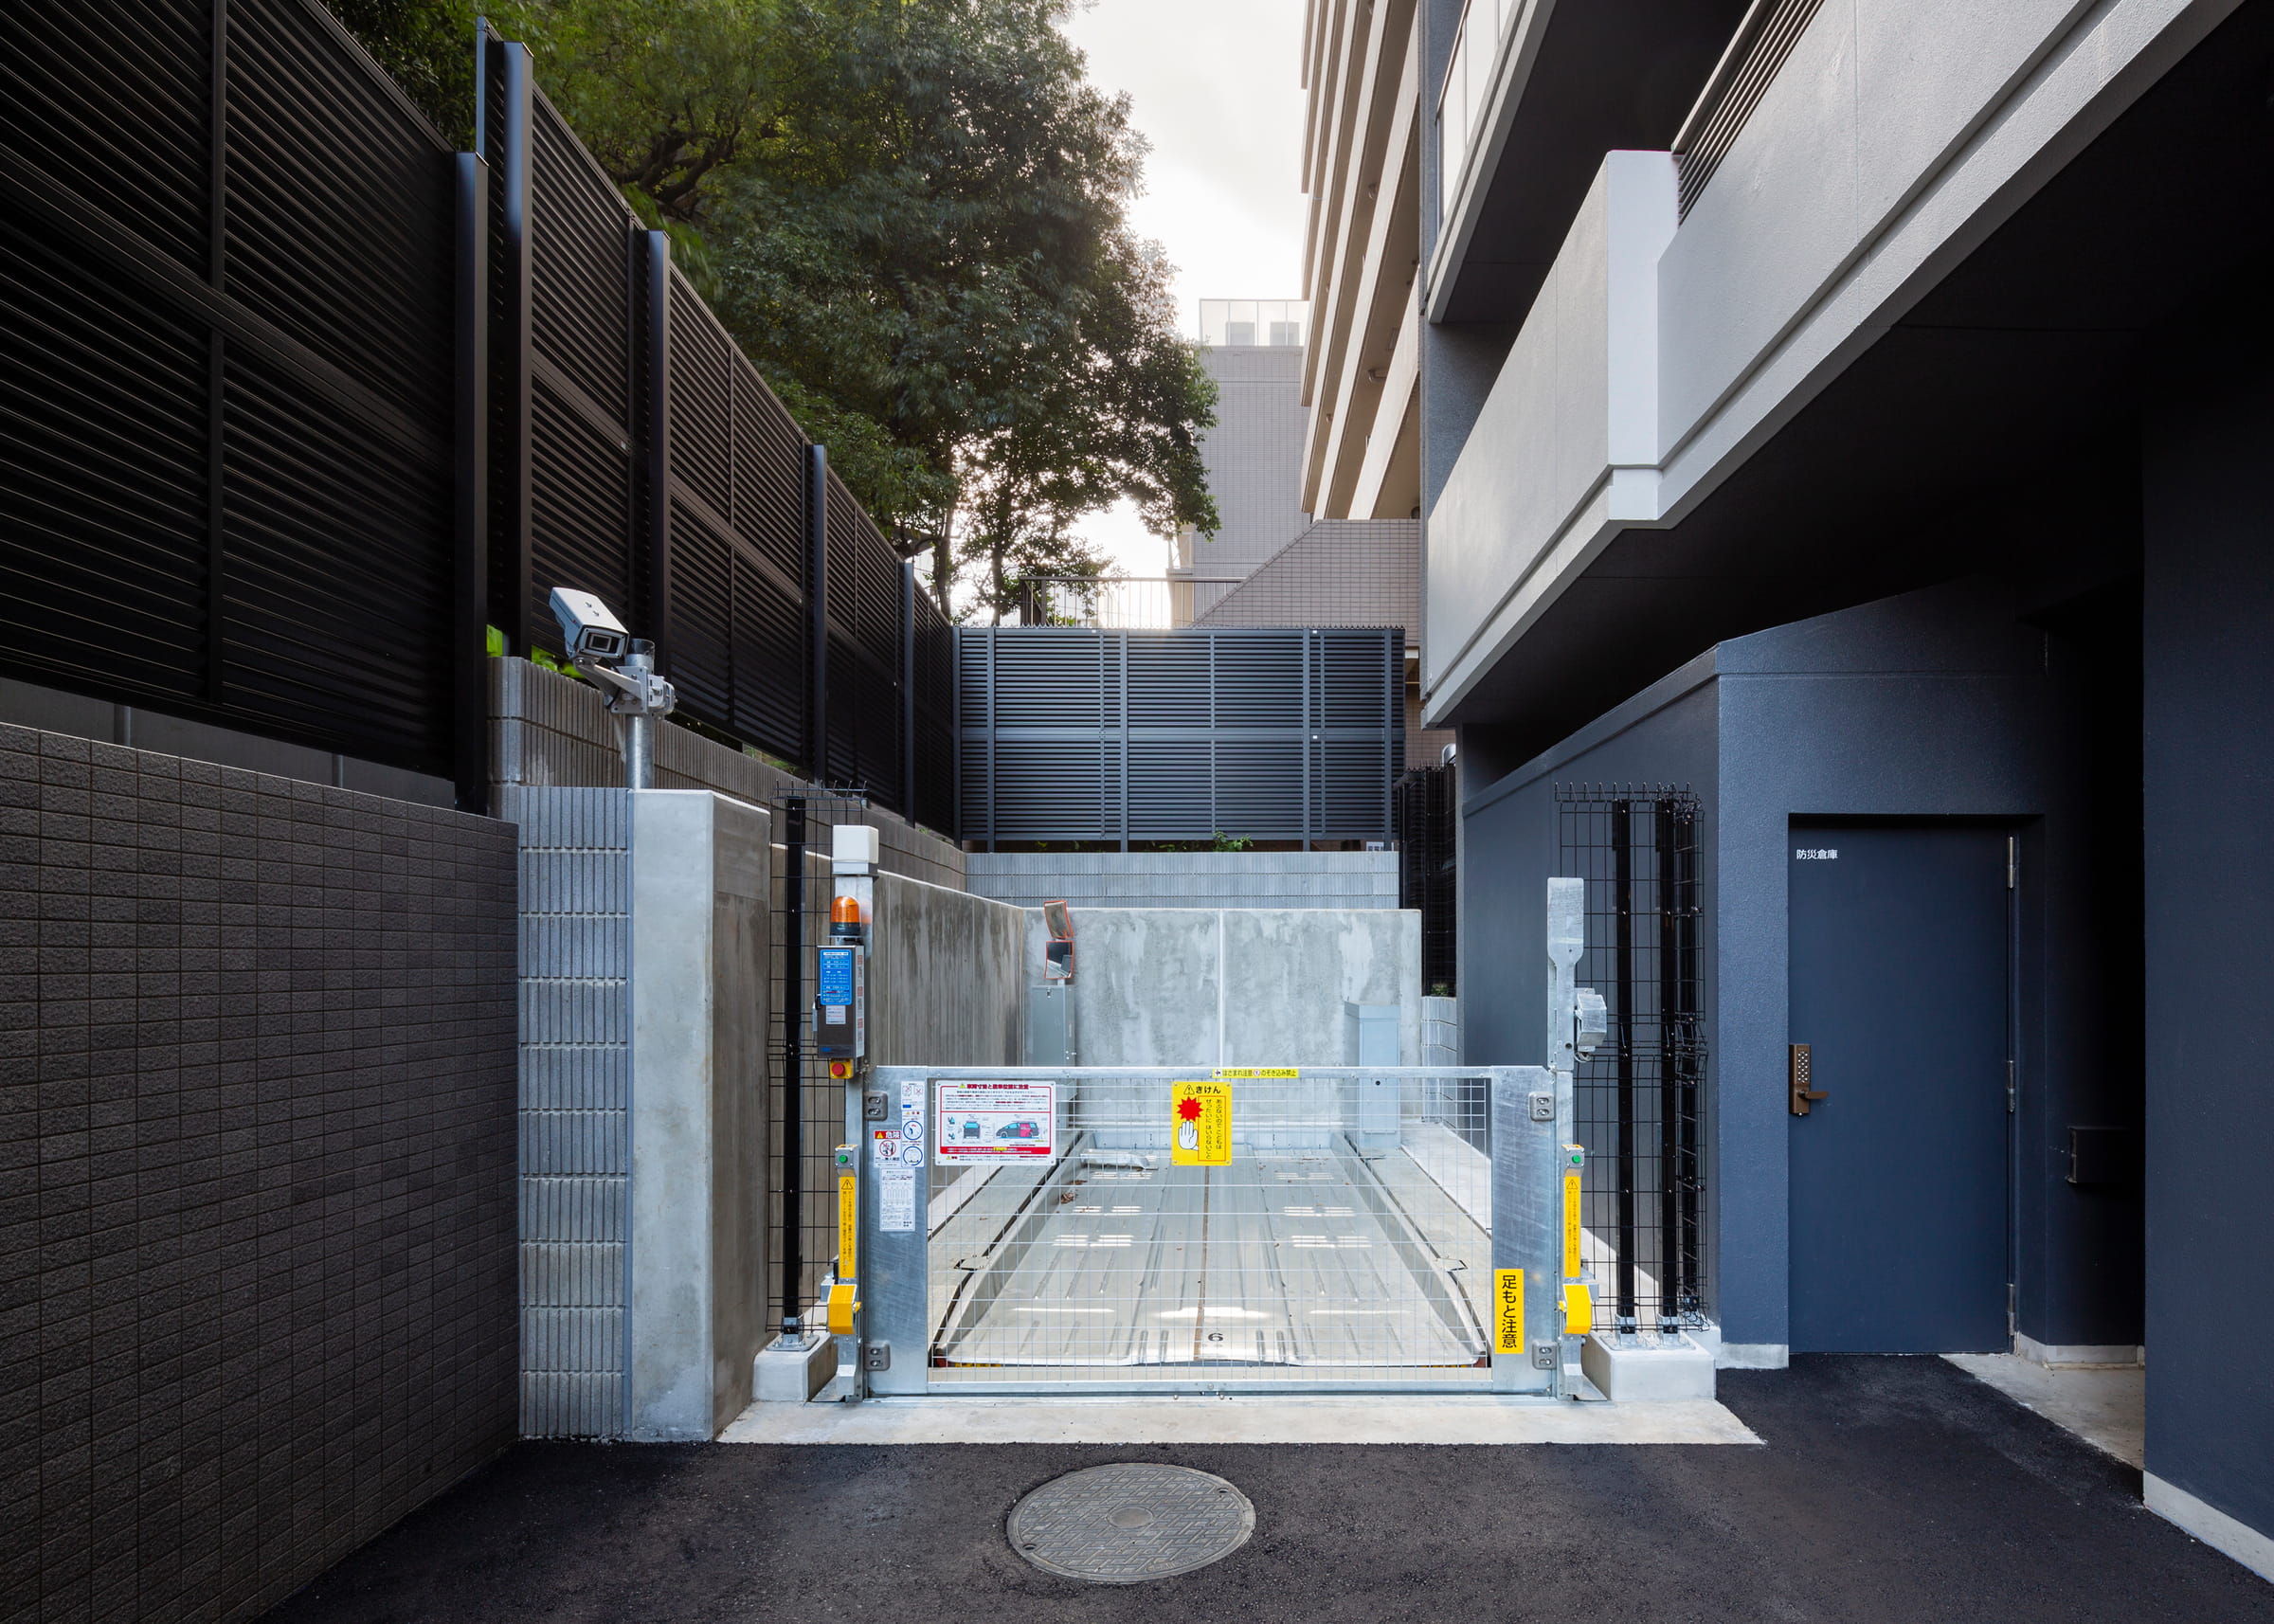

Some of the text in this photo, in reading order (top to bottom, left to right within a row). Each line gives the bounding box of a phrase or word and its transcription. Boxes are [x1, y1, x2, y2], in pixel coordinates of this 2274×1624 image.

[1796, 849, 1838, 859] 防災倉庫
[1196, 1086, 1221, 1094] きけん
[1502, 1274, 1517, 1348] 足もと注意
[1208, 1332, 1223, 1342] 6
